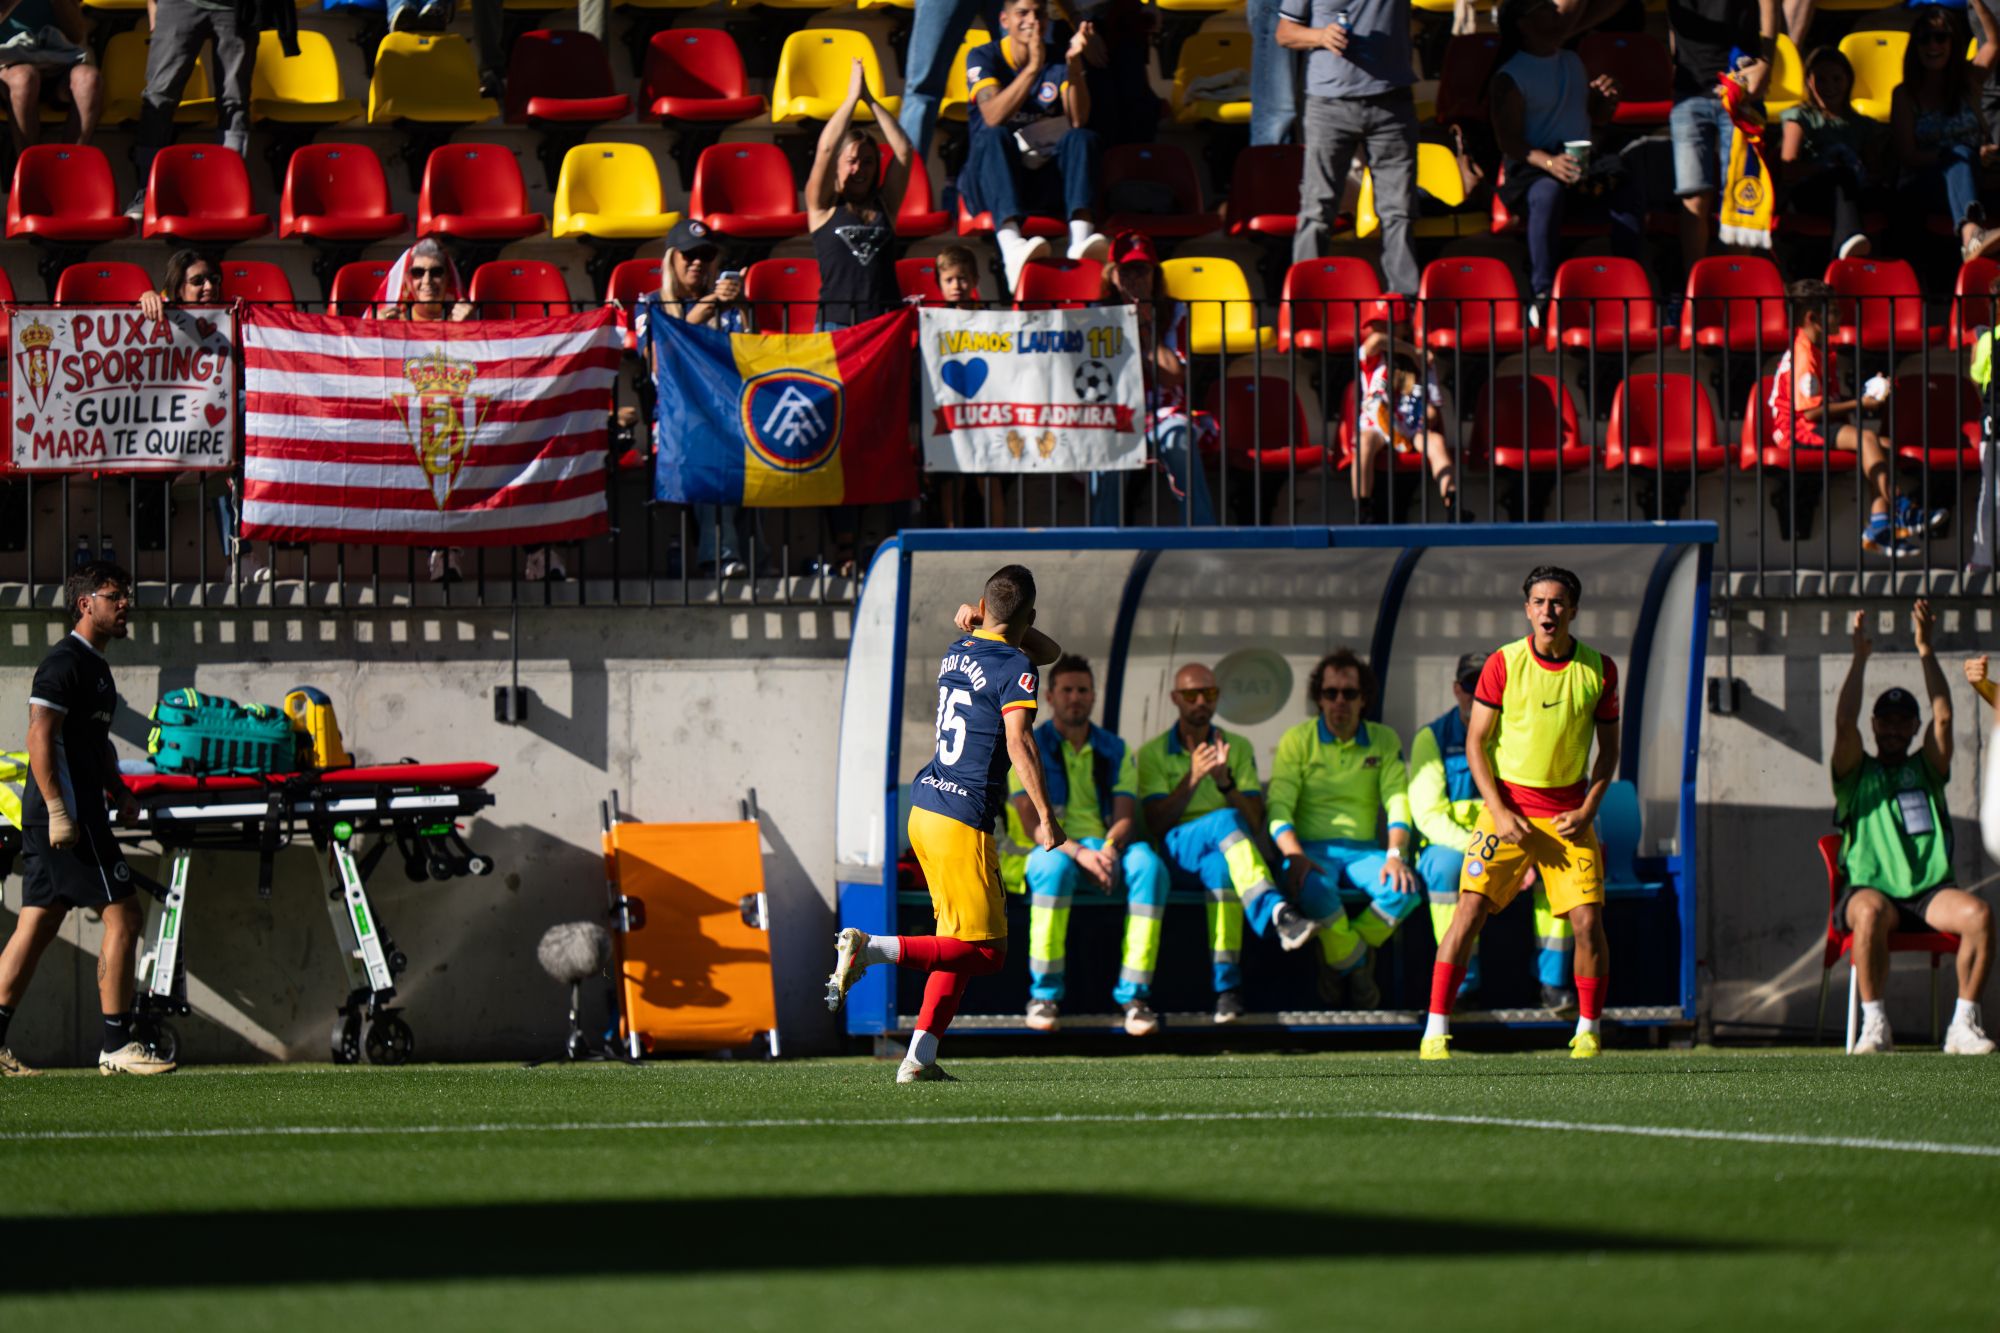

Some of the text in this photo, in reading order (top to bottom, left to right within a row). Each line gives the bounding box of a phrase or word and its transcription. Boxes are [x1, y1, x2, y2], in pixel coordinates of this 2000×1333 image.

[71, 313, 174, 352] PUXA
[1087, 326, 1123, 358] 11!
[62, 347, 228, 393] SPORTING!
[75, 394, 187, 427] GUILLE
[954, 405, 1117, 425] LUCAS TE ADMIRA
[32, 429, 225, 460] MARA TE QUIERE
[959, 654, 987, 692] CANO
[935, 686, 972, 766] 15
[1467, 831, 1499, 861] 28
